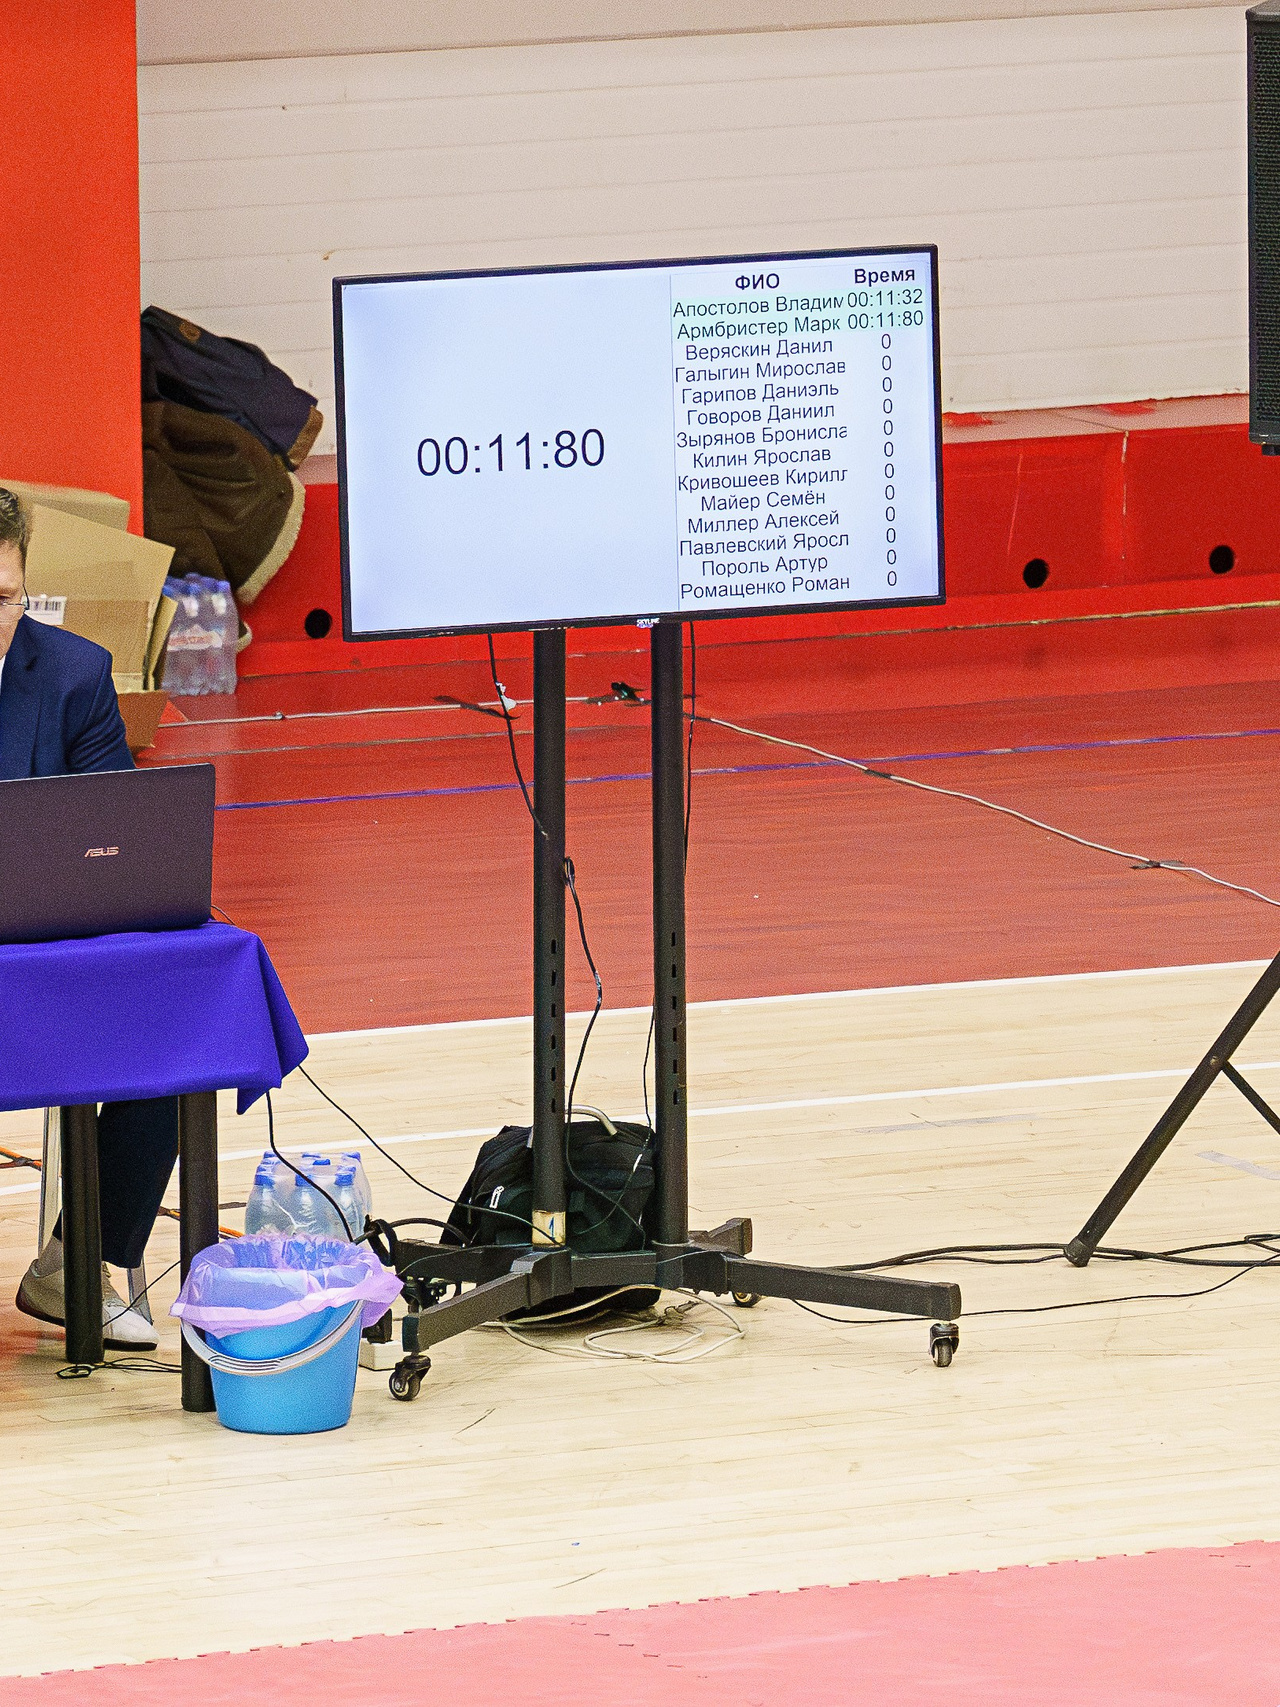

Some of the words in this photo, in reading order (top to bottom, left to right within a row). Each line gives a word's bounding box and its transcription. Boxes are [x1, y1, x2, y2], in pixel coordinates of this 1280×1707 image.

[734, 273, 780, 291] ФИО
[853, 268, 915, 287] Время
[673, 301, 770, 318] Апостолов
[847, 289, 923, 307] 00:11:32
[677, 322, 788, 342] Армбристер
[794, 316, 841, 333] Марк
[848, 310, 924, 330] 00:11:80
[685, 344, 771, 363] Веряскин
[776, 339, 833, 359] Данил
[881, 333, 892, 350] 0
[675, 366, 750, 384] Галыгин
[756, 361, 846, 380] Мирослав
[881, 355, 892, 371] 0
[682, 388, 757, 406] Гарипов
[762, 383, 840, 403] Даниэль
[882, 376, 893, 393] 0
[687, 409, 762, 427] Говоров
[767, 404, 835, 425] Даниил
[882, 398, 893, 415] 0
[676, 431, 756, 450] Зырянов
[883, 420, 894, 436] 0
[417, 428, 605, 476] 00:11:80
[693, 453, 748, 469] Килин
[754, 449, 832, 468] Ярослав
[884, 441, 894, 458] 0
[678, 474, 780, 494] Кривошеев
[884, 463, 895, 479] 0
[701, 495, 761, 512] Майер
[766, 490, 826, 508] Семён
[885, 484, 896, 501] 0
[688, 517, 759, 535] Миллер
[764, 510, 840, 530] Алексей
[885, 506, 896, 522] 0
[680, 536, 787, 557] Павлевский
[793, 533, 850, 552] Яросл
[886, 527, 897, 544] 0
[702, 561, 770, 578] Пороль
[775, 556, 828, 575] Артур
[886, 549, 897, 566] 0
[681, 580, 786, 600] Ромащенко
[792, 576, 850, 593] Роман
[887, 571, 898, 587] 0
[84, 846, 119, 858] ASUS
